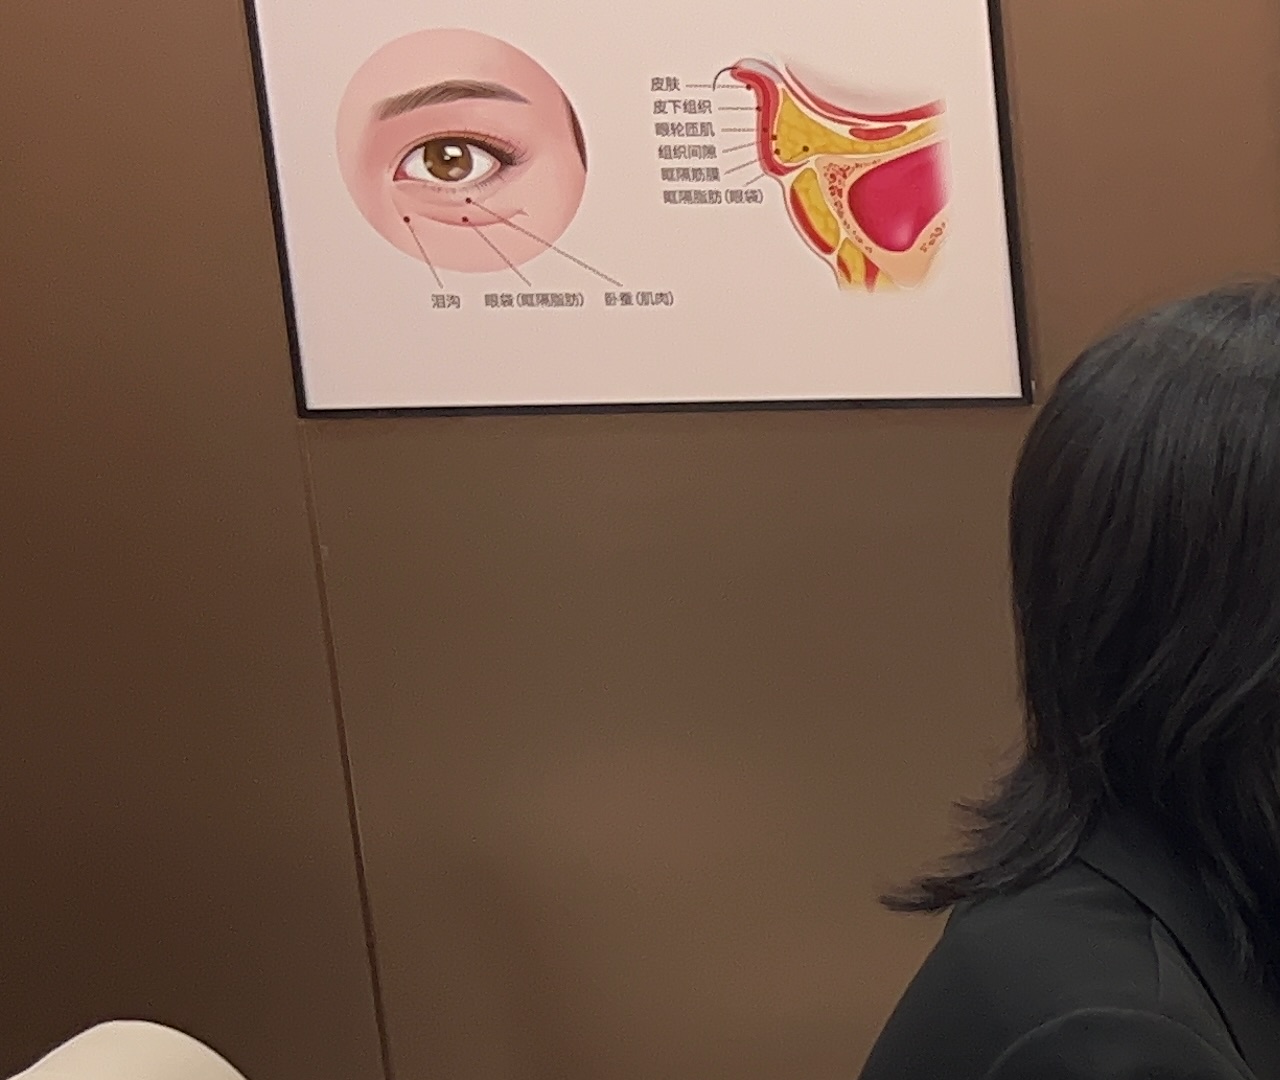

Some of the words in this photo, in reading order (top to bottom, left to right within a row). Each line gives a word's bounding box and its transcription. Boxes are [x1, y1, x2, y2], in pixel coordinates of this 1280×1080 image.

[650, 76, 681, 92] 皮肤
[653, 99, 713, 114] 皮下组织
[658, 144, 718, 160] 组织间隙
